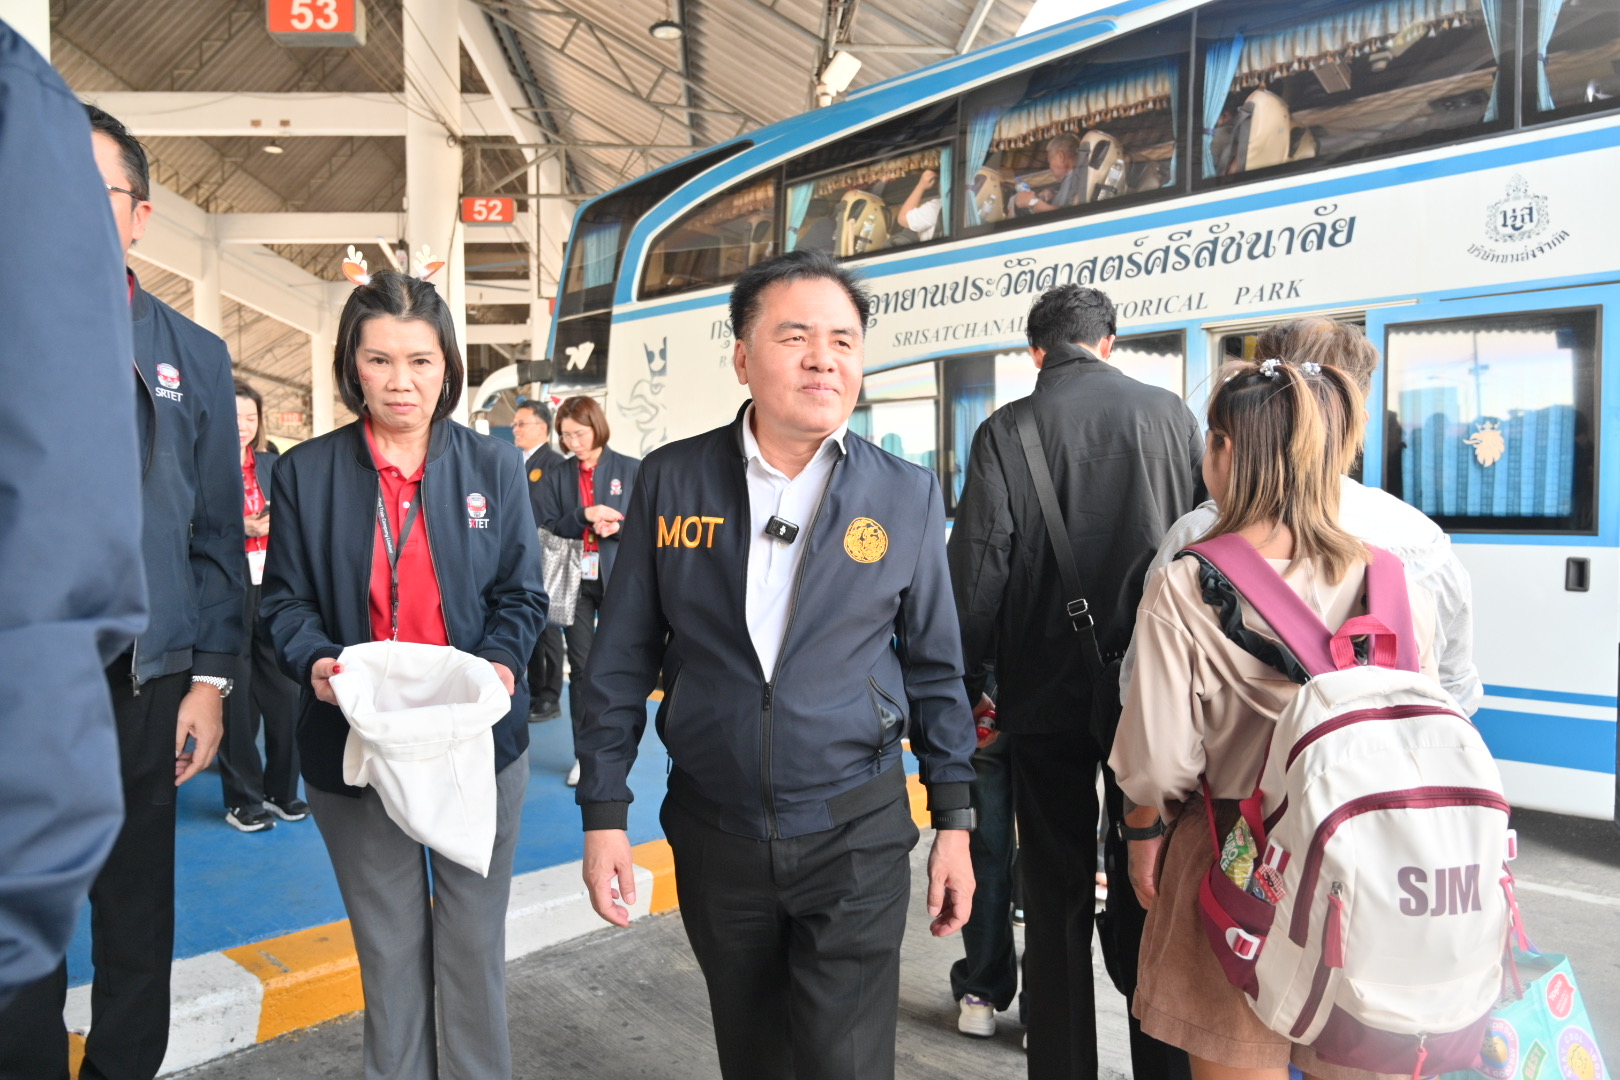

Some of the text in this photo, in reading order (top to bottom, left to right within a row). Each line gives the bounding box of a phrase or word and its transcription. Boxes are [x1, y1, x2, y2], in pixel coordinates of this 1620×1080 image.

[290, 0, 339, 30] 53
[473, 199, 503, 221] 52
[893, 278, 1305, 348] SRISATCHANAL TORICAL PARK
[155, 386, 184, 402] SRTET
[381, 518, 390, 539] Company
[657, 515, 725, 549] MOT
[385, 537, 394, 554] Limited
[1397, 863, 1482, 917] SJM
